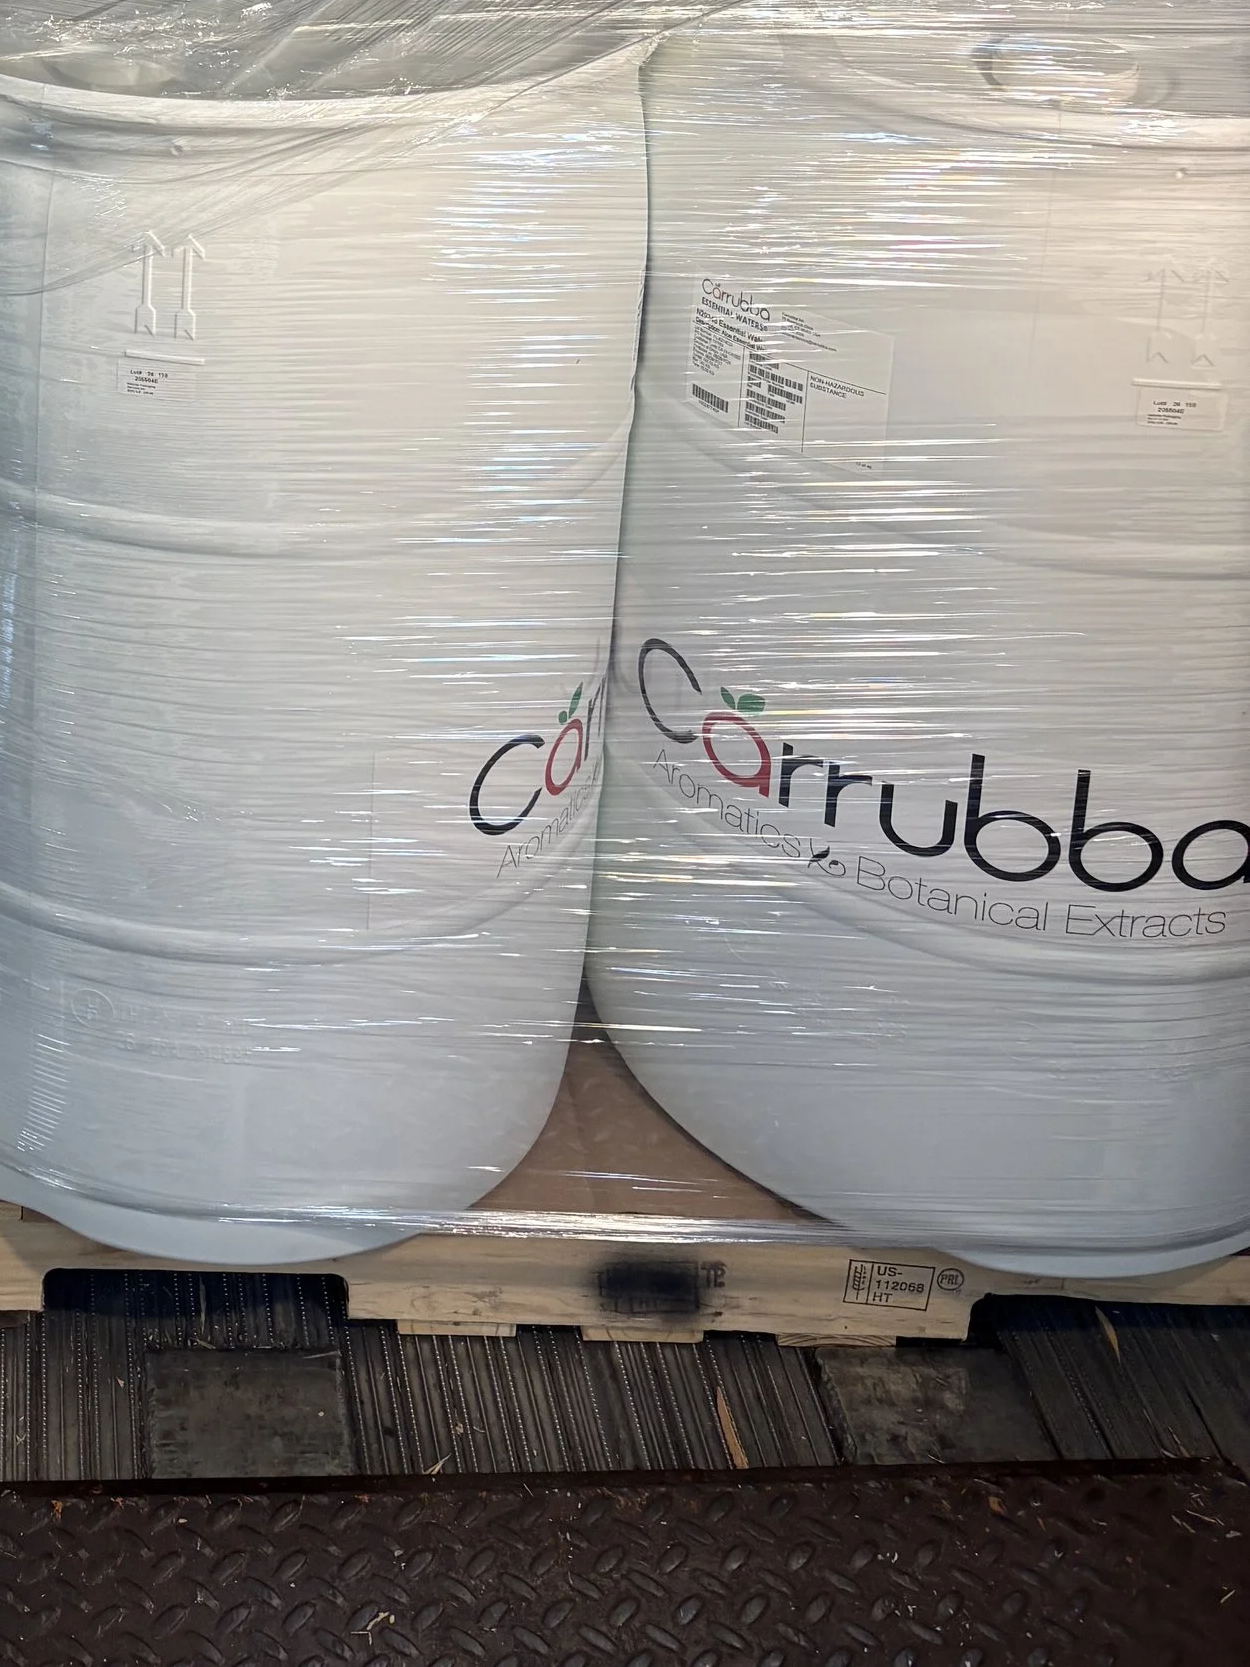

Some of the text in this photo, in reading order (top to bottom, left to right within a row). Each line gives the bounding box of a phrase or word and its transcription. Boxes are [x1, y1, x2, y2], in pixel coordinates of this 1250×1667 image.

[652, 748, 802, 859] Aromatics
[856, 855, 1049, 932] Botanical
[1065, 904, 1227, 939] Extracts
[877, 1265, 903, 1278] US-
[875, 1279, 926, 1294] 112068
[872, 1291, 893, 1304] HT
